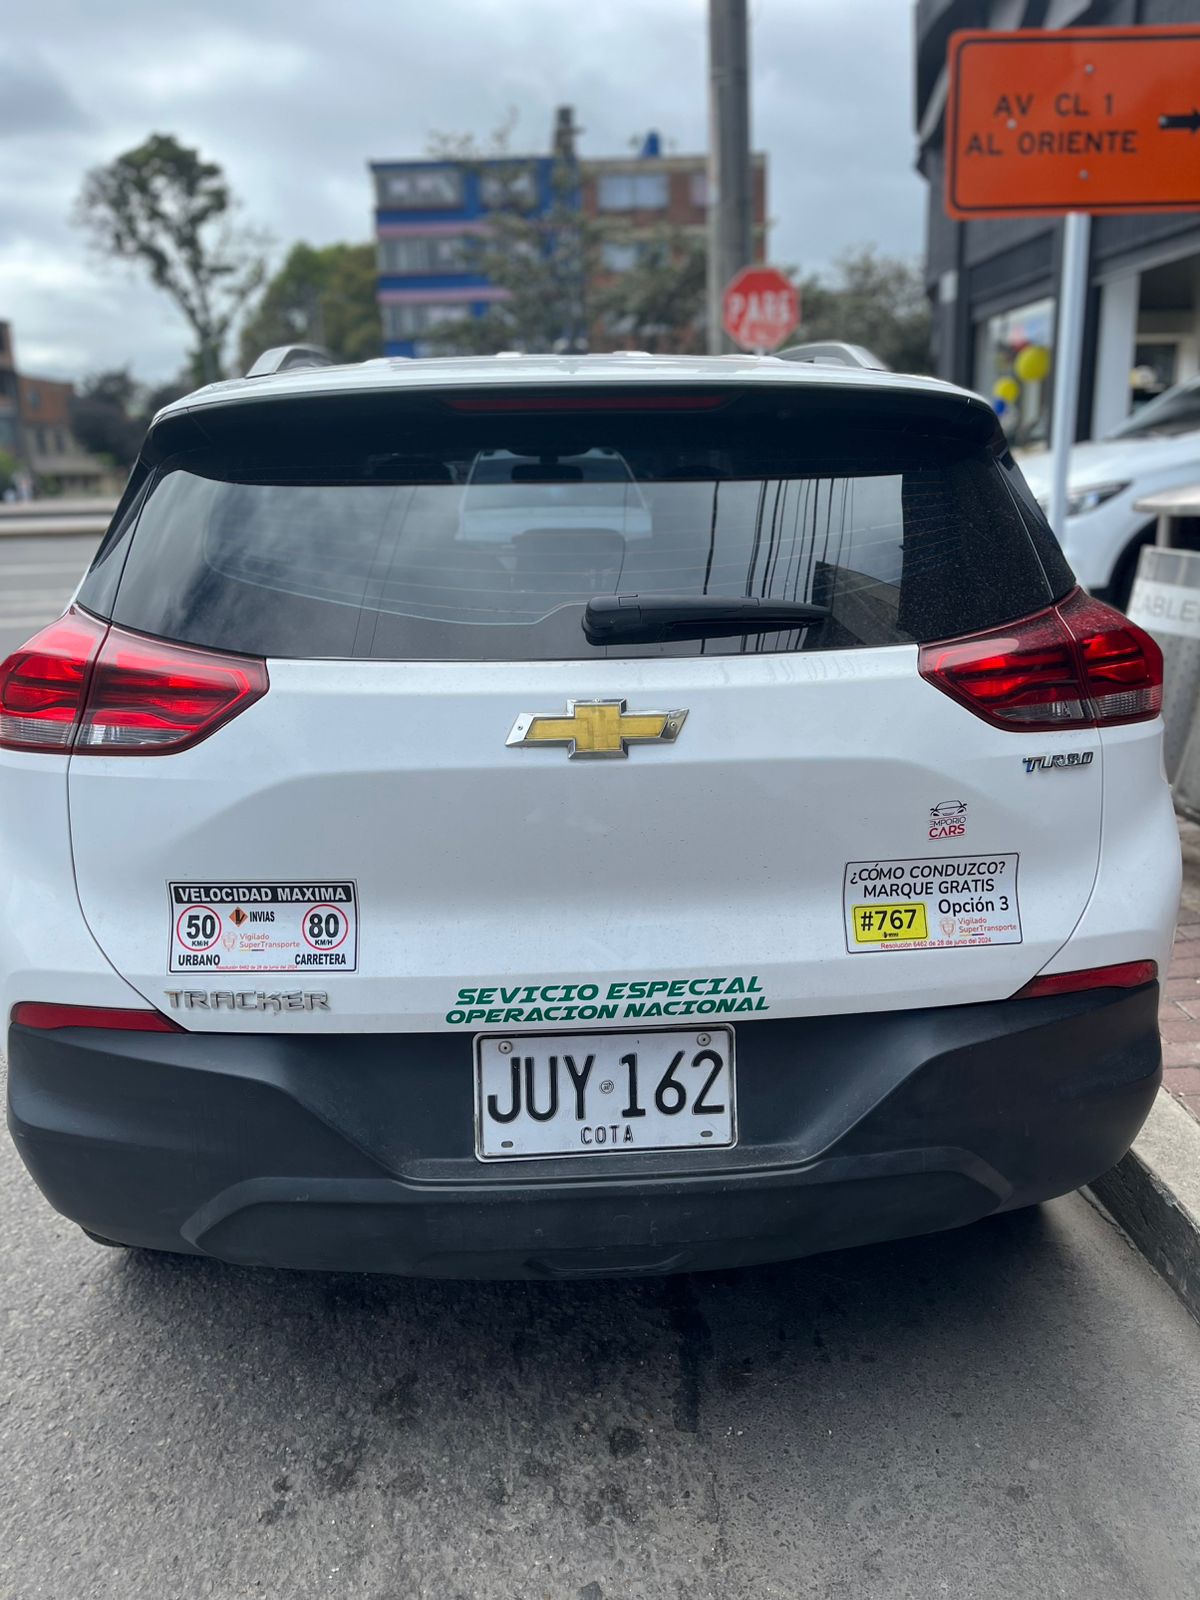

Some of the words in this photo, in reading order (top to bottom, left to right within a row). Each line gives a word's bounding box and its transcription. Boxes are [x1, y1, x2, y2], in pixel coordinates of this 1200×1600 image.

[994, 94, 1034, 118] AV
[1055, 93, 1089, 117] CL
[966, 133, 1001, 156] AL
[1018, 130, 1137, 155] ORIENTE
[1023, 752, 1093, 772] TURBO
[929, 816, 967, 828] EMPORIO
[929, 825, 965, 838] CARS
[850, 864, 905, 884] ¿CÓMO
[910, 861, 1006, 879] CONDUZCO?
[178, 888, 272, 902] VELOCIDAD
[277, 887, 347, 901] MAXIMA
[863, 882, 933, 899] MARQUE
[939, 879, 995, 894] GRATIS
[938, 897, 994, 917] Opción
[1000, 896, 1009, 911] 3
[186, 914, 216, 940] 50
[249, 911, 275, 923] INVIAS
[309, 913, 340, 939] 80
[860, 909, 917, 931] #767
[958, 917, 987, 926] Vigilado
[239, 933, 270, 942] Vigilado
[959, 924, 1017, 934] SuperTransporte
[239, 940, 300, 949] SuperTransporte
[315, 939, 333, 947] KM/H
[178, 954, 221, 966] URBANO
[295, 953, 346, 966] CARRETERA
[164, 989, 330, 1011] TRACKER
[455, 984, 599, 1005] SEVICIO
[606, 976, 764, 999] ESPECIAL
[445, 1003, 619, 1024] OPERACION
[623, 996, 770, 1018] NACIONAL
[487, 1054, 596, 1124] JUY
[619, 1049, 725, 1118] 162
[580, 1124, 634, 1145] COTA
